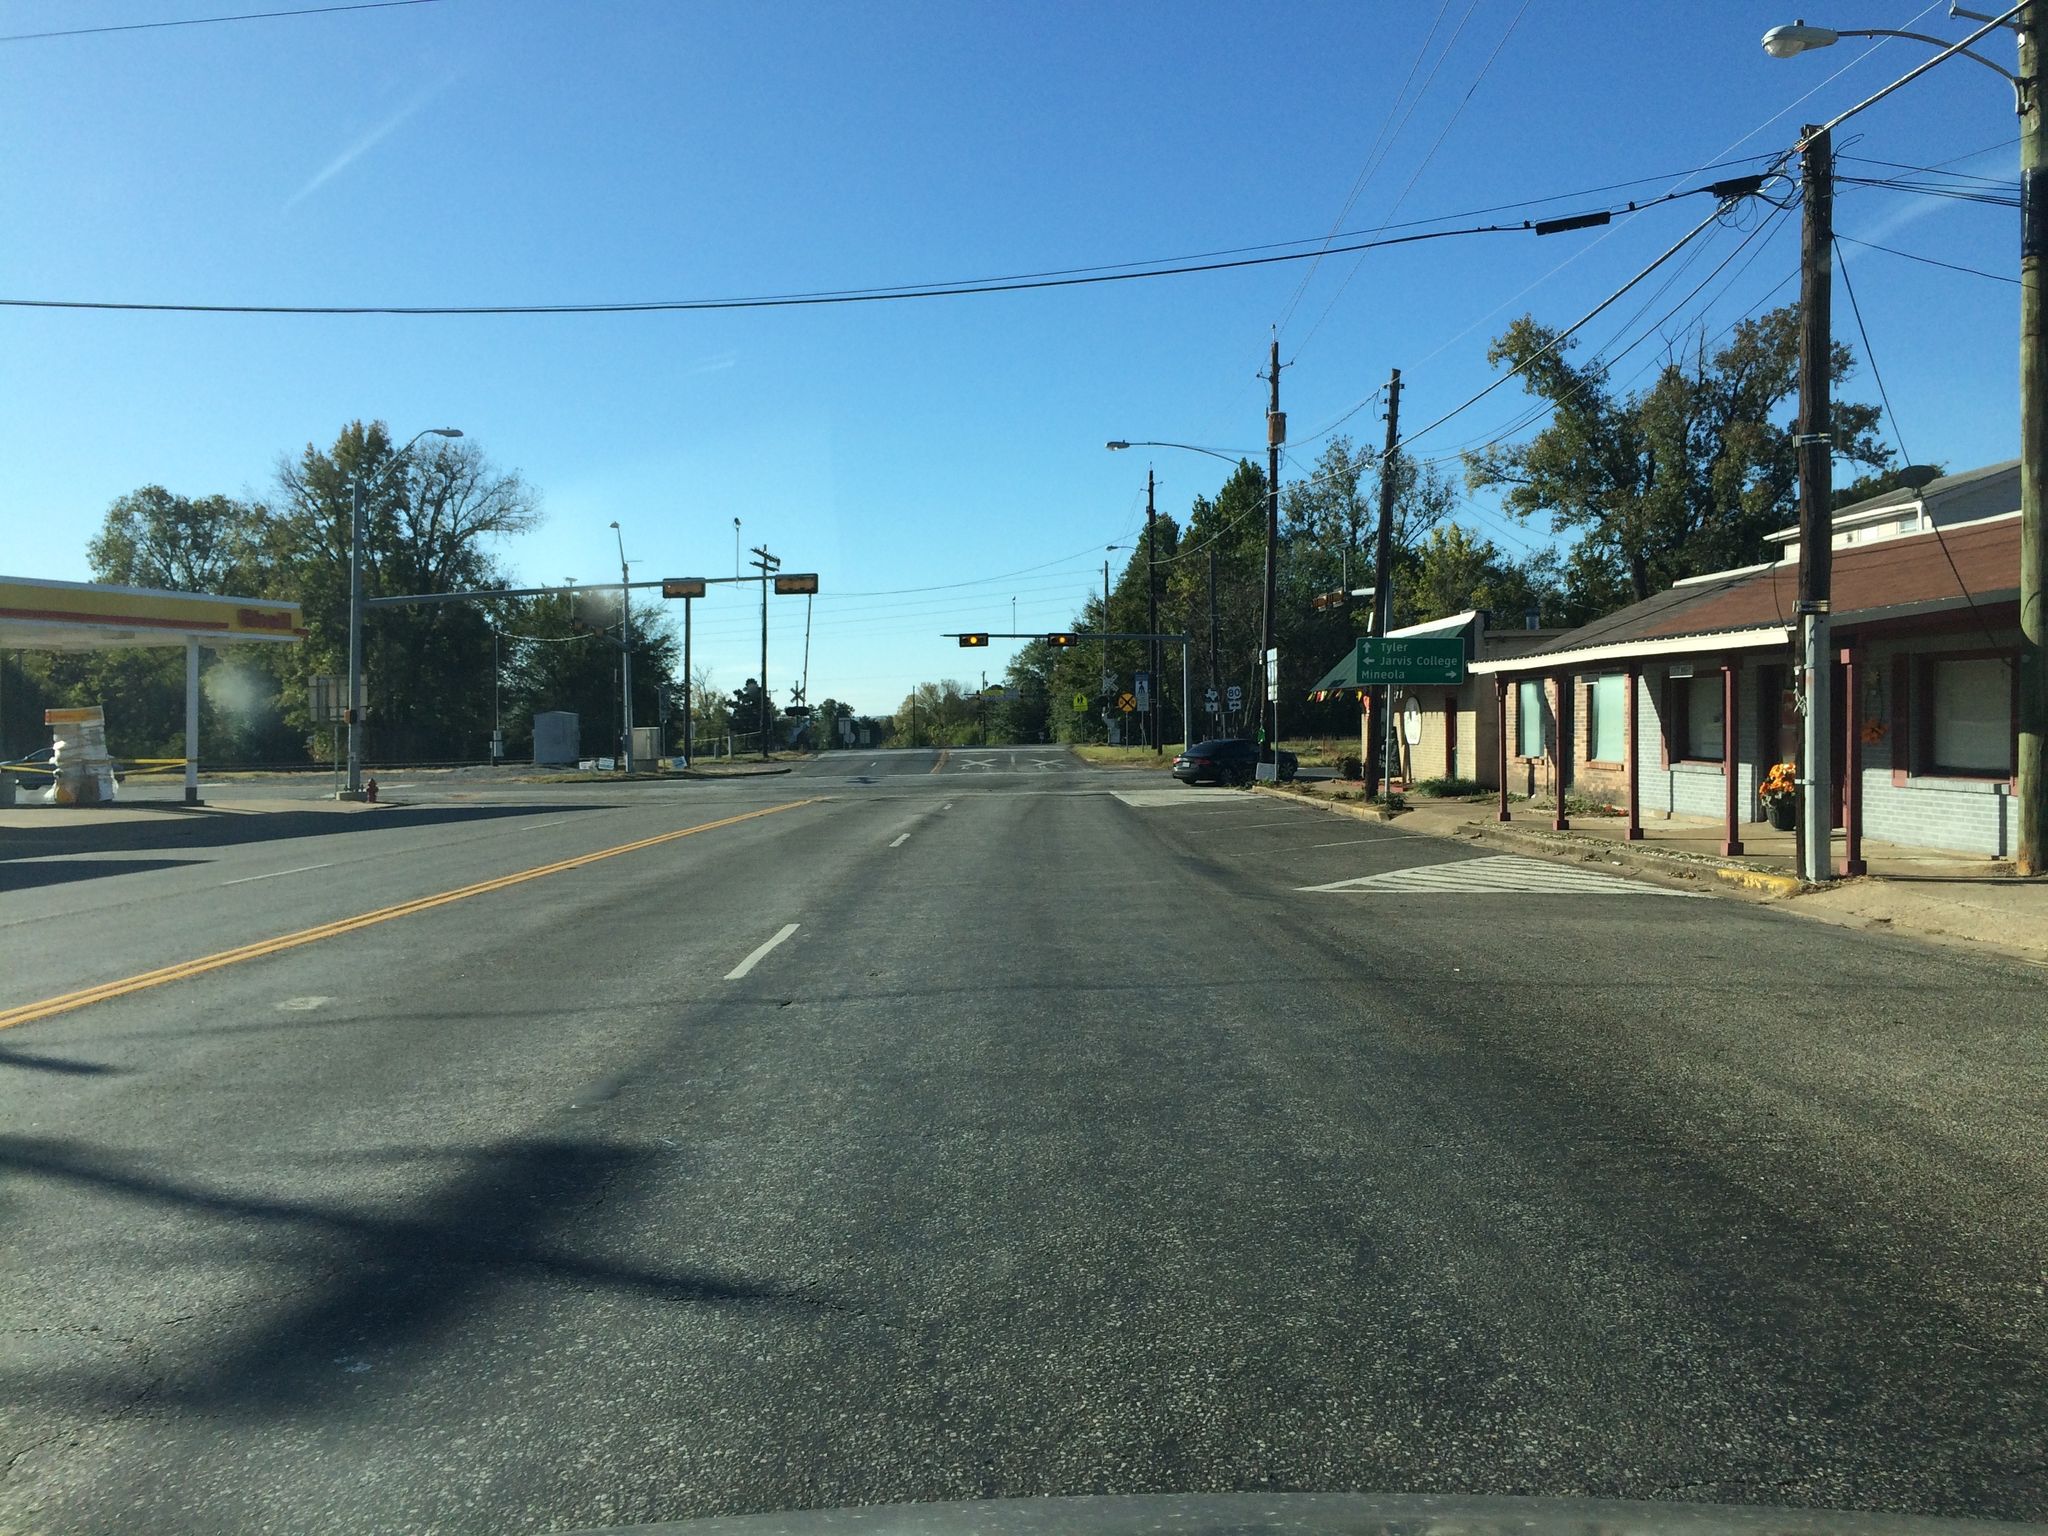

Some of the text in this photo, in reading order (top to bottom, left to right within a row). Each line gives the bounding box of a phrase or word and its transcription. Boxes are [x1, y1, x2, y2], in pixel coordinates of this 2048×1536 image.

[1381, 642, 1408, 654] Tyler
[1380, 656, 1458, 668] Jarvis College
[1361, 669, 1405, 680] Mineola
[1228, 688, 1241, 698] 80
